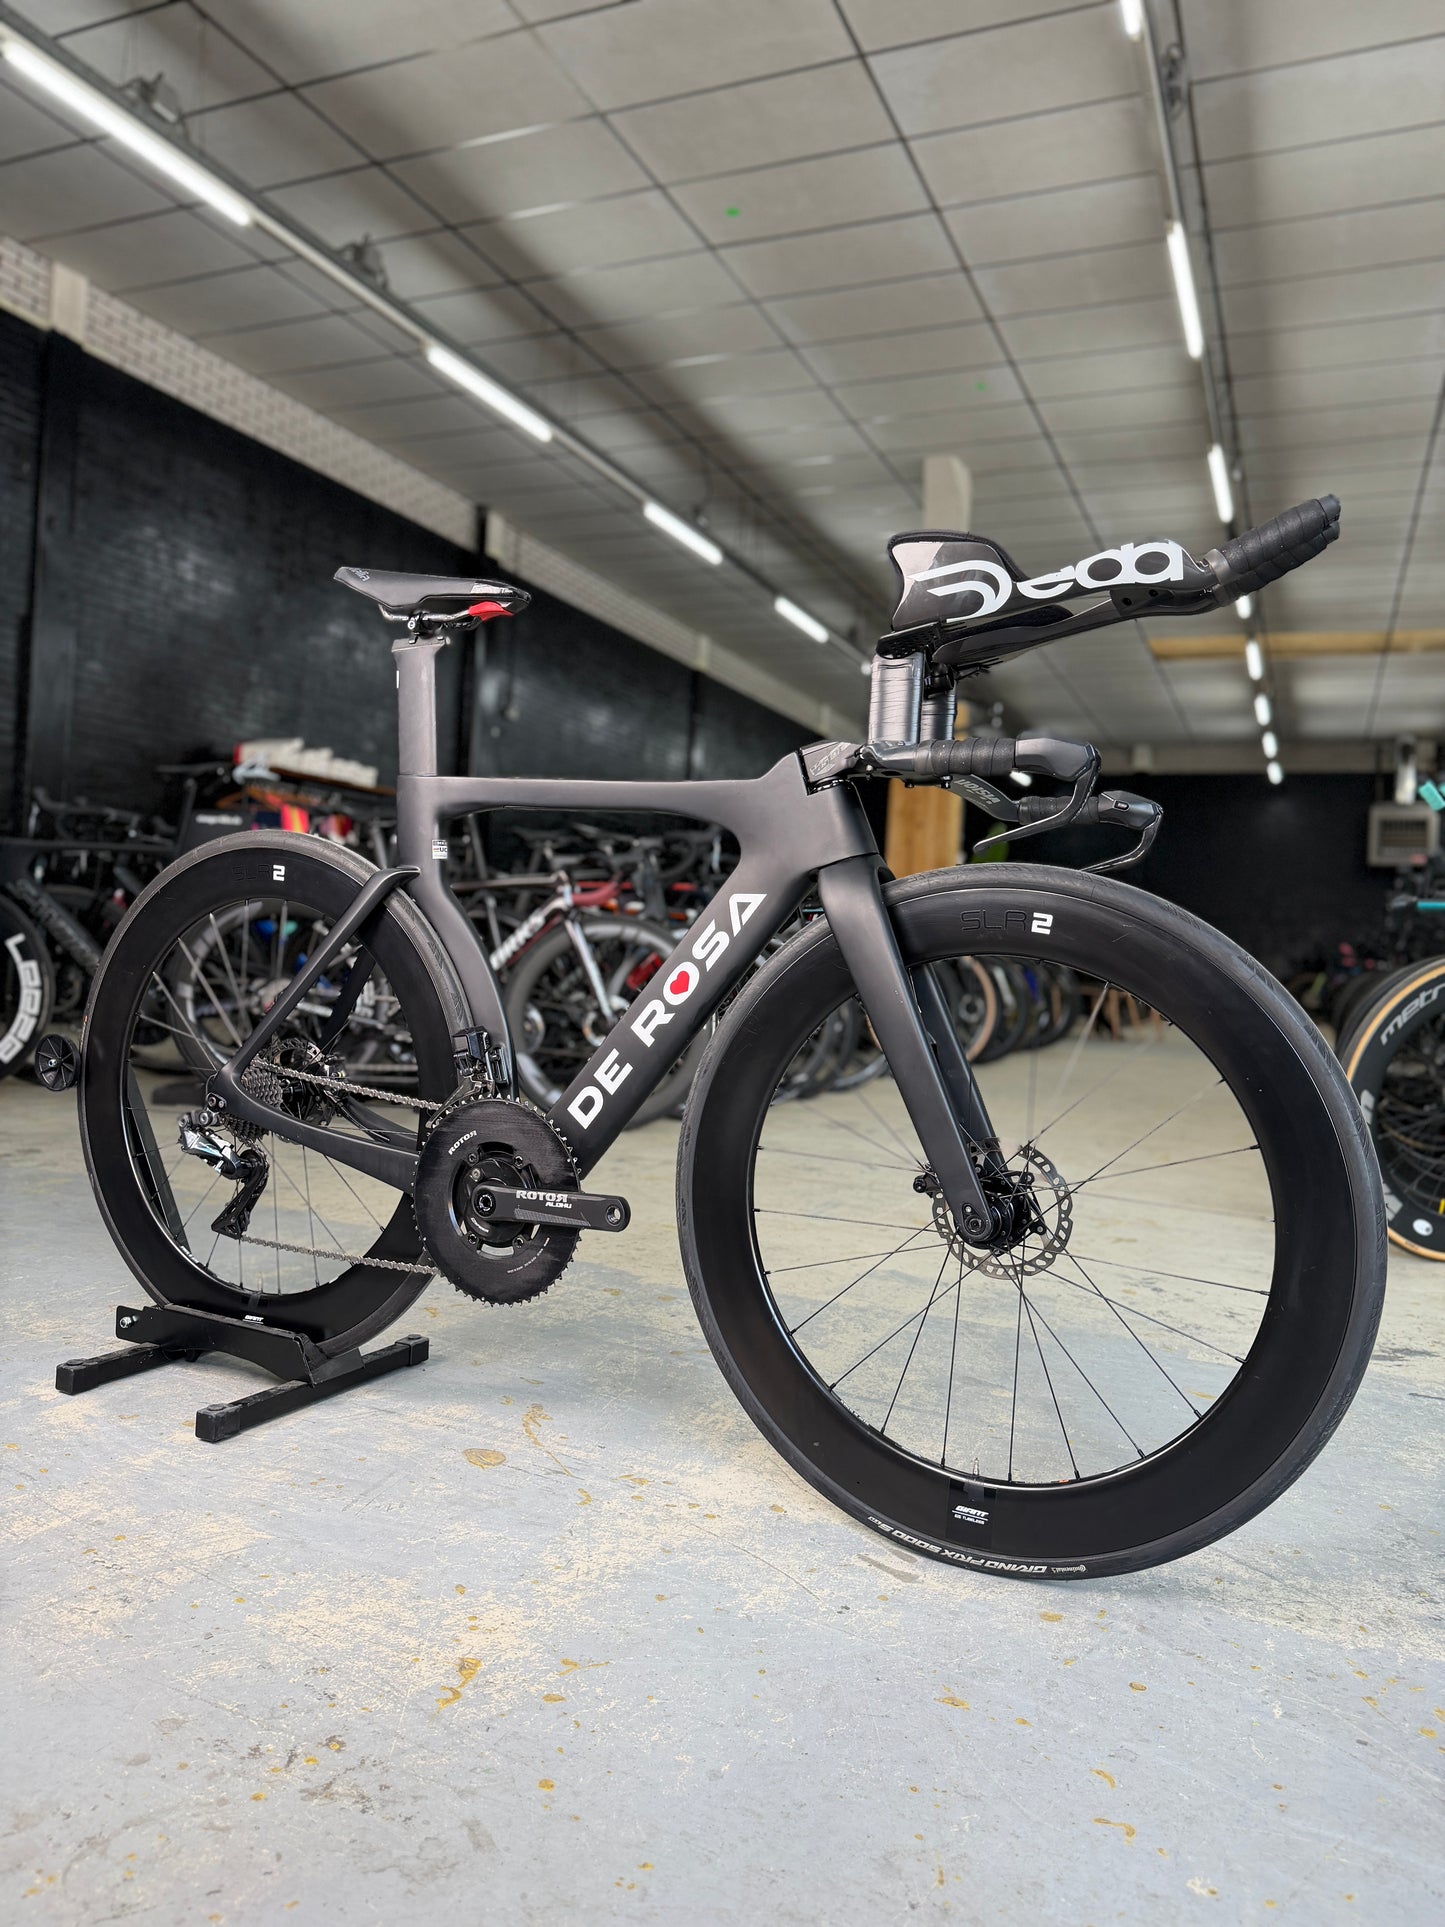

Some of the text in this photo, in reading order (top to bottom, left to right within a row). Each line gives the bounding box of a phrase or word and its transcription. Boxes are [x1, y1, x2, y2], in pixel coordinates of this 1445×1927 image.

[567, 892, 768, 1129] DE ROSA
[448, 1130, 477, 1156] ROTOR
[515, 1189, 568, 1203] ROTOR
[955, 1505, 989, 1517] GIANT
[891, 1529, 943, 1554] 5000
[942, 1549, 987, 1566] PRIX
[985, 1560, 1048, 1574] GRAND
